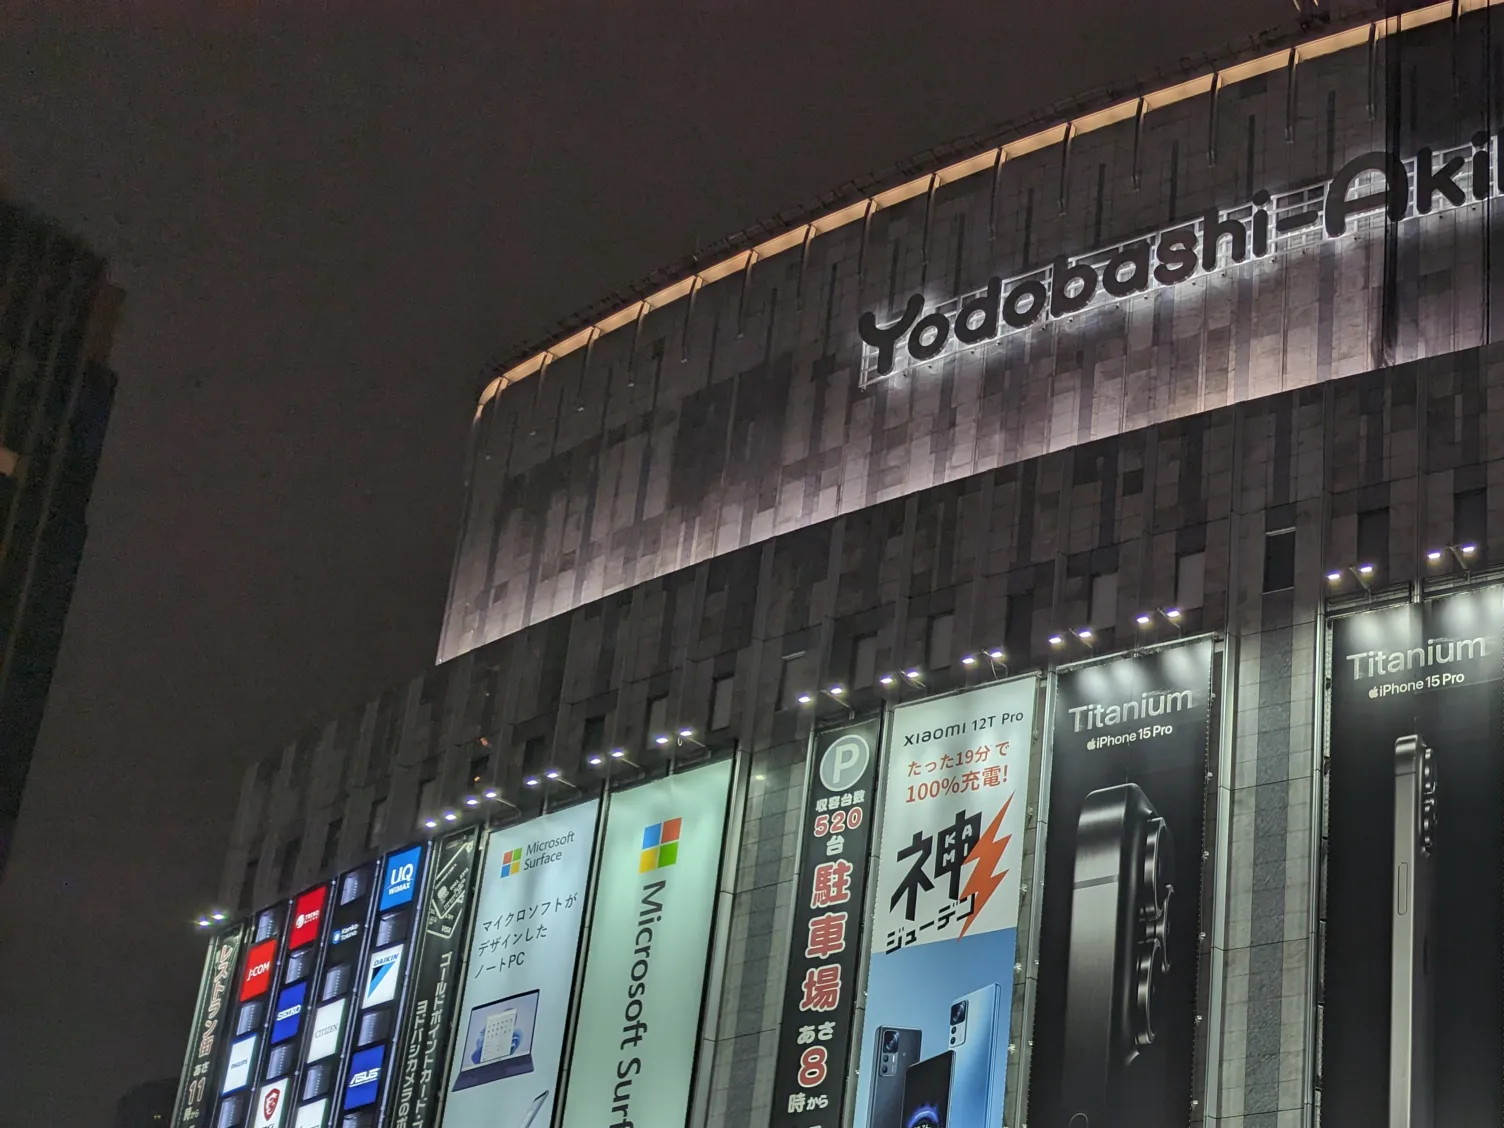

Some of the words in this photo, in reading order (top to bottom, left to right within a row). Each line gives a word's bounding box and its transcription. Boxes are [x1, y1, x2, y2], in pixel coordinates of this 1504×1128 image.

[1345, 635, 1488, 682] Titanium
[1379, 677, 1424, 699] iPhone
[1425, 674, 1440, 688] 15
[1441, 671, 1466, 686] Pro
[971, 715, 997, 733] 12T
[1001, 711, 1024, 727] Pro
[1067, 686, 1194, 734] Titanium
[1095, 730, 1137, 750] iPhone
[1137, 725, 1151, 741] 15
[1152, 722, 1174, 739] Pro
[906, 740, 1011, 778] たった19分で
[905, 763, 1009, 804] 100%充電!
[814, 789, 866, 814] 収容台数
[813, 806, 863, 838] 520
[525, 830, 577, 857] Microsoft
[825, 835, 845, 857] 台
[390, 863, 415, 884] UQ
[523, 849, 563, 871] Surface
[482, 891, 578, 934] マイクロソフトが
[477, 923, 549, 957] デザインした
[798, 858, 854, 1014] 駐車場
[373, 952, 400, 967] DAIKIN
[474, 951, 526, 979] ノートPC
[619, 879, 667, 1051] Microsoft
[276, 1004, 302, 1022] SEIKO
[796, 1021, 836, 1045] あさ
[350, 1067, 381, 1086] ASUS
[797, 1044, 828, 1089] 8
[787, 1093, 829, 1115] 時から
